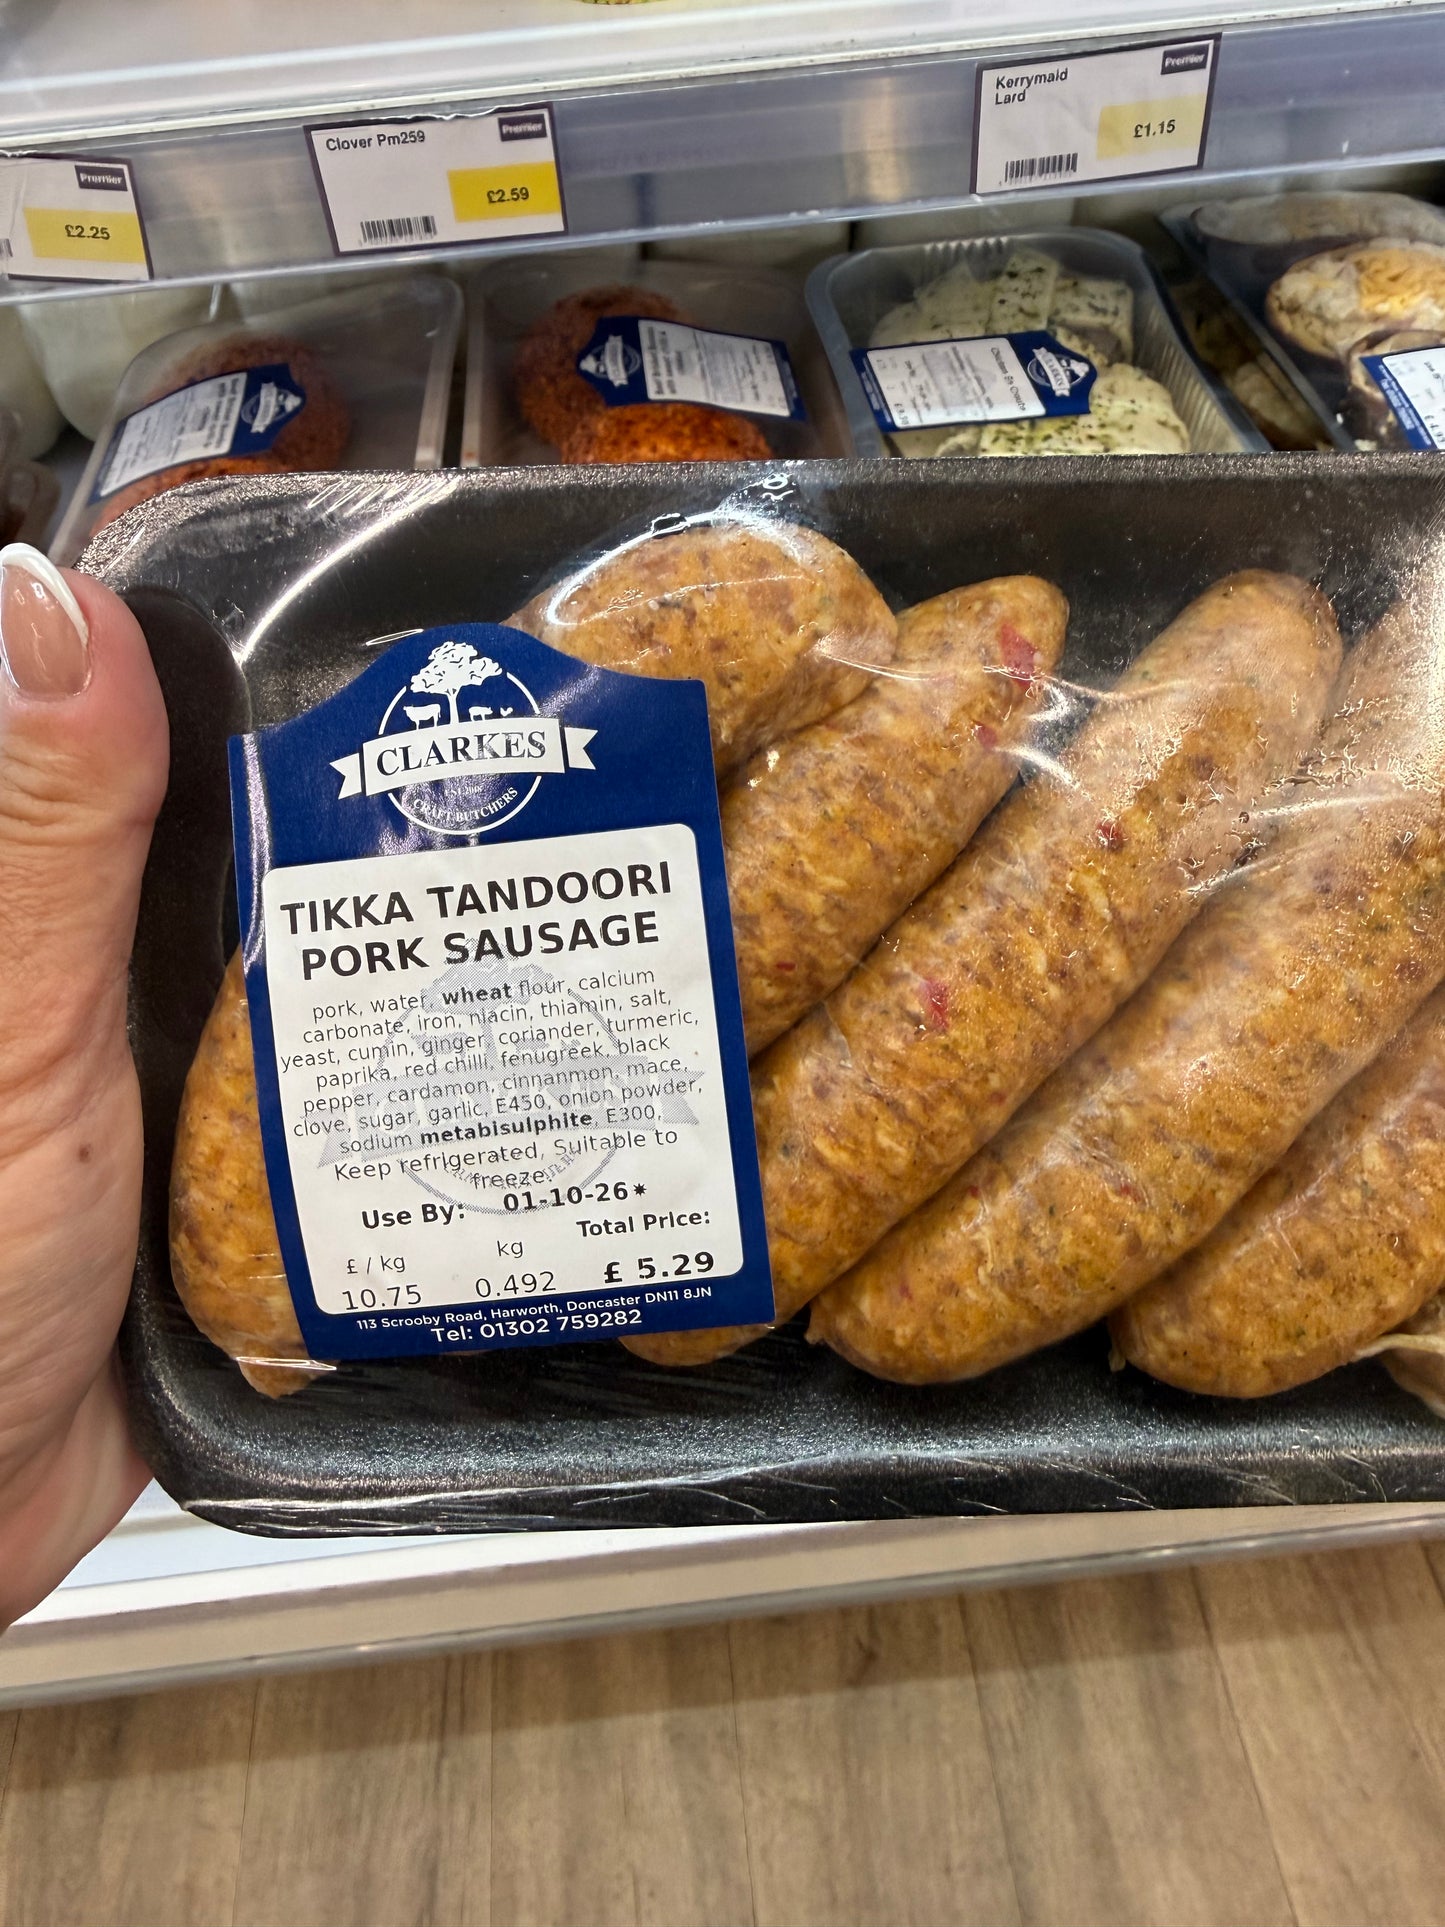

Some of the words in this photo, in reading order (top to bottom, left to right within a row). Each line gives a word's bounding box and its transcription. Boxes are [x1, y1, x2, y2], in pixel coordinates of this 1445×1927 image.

[1164, 53, 1205, 67] Premier
[995, 68, 1068, 90] Kerrymaid
[994, 89, 1026, 105] Lard
[325, 136, 372, 151] Clover
[377, 130, 426, 147] Pm259
[501, 122, 543, 134] Premier
[1133, 119, 1176, 138] £1.15
[79, 172, 122, 184] Premier
[486, 187, 530, 205] £2.59
[65, 224, 110, 240] £2.25
[376, 731, 546, 776] CLARKES
[412, 797, 451, 821] CRAFT
[456, 787, 518, 822] BUTCHERS
[280, 891, 414, 936] TIKKA
[426, 861, 672, 919] TANDOORI
[302, 937, 429, 981] PORK
[444, 911, 660, 965] SAUSAGE
[313, 1000, 363, 1023] pork,
[370, 993, 434, 1013] water,
[442, 982, 512, 1005] wheat
[578, 970, 655, 991] calcium
[303, 1019, 411, 1043] carbonate,
[418, 1013, 462, 1032] iron,
[469, 1004, 534, 1026] niacin,
[541, 996, 623, 1018] thiamin,
[630, 988, 671, 1009] salt,
[280, 1047, 340, 1073] yeast,
[348, 1041, 414, 1061] cumin,
[422, 1032, 488, 1058] ginger,
[498, 1021, 600, 1047] coriander,
[607, 1009, 698, 1033] turmeric,
[316, 1066, 397, 1092] paprika,
[405, 1058, 437, 1077] red
[444, 1053, 495, 1074] chilli,
[501, 1041, 611, 1068] fenugreek,
[618, 1033, 671, 1054] black
[303, 1090, 379, 1116] pepper,
[387, 1079, 496, 1103] cardamon,
[502, 1066, 619, 1091] cinnanmon,
[627, 1057, 688, 1077] mace,
[293, 1118, 351, 1137] clove,
[359, 1108, 421, 1131] sugar,
[428, 1099, 489, 1125] garlic,
[495, 1093, 551, 1115] E450,
[559, 1088, 614, 1107] onion
[621, 1078, 702, 1104] powder,
[339, 1133, 413, 1155] sodium
[421, 1112, 599, 1146] metabisulphite,
[606, 1104, 661, 1124] E300,
[335, 1160, 391, 1181] Keep
[400, 1141, 544, 1174] refrigerated,
[554, 1130, 646, 1157] Suitable
[655, 1127, 678, 1146] to
[362, 1208, 411, 1229] Use
[421, 1203, 465, 1225] By:
[576, 1215, 634, 1238] Total
[643, 1210, 710, 1231] Price:
[497, 1240, 524, 1259] kg
[346, 1259, 358, 1275] £
[366, 1257, 372, 1275] /
[380, 1255, 406, 1273] kg
[604, 1261, 623, 1284] £
[637, 1251, 714, 1280] 5.29
[342, 1284, 422, 1311] 10.75
[475, 1271, 557, 1298] 0.492
[356, 1319, 378, 1330] 113
[381, 1315, 440, 1330] Scrooby
[445, 1311, 487, 1324] Road,
[491, 1302, 562, 1320] Harworth,
[566, 1295, 640, 1312] Doncaster
[645, 1290, 679, 1304] DN11
[683, 1286, 712, 1299] 8JN
[431, 1326, 474, 1343] Tel:
[479, 1318, 550, 1338] 01302
[556, 1309, 643, 1331] 759282
